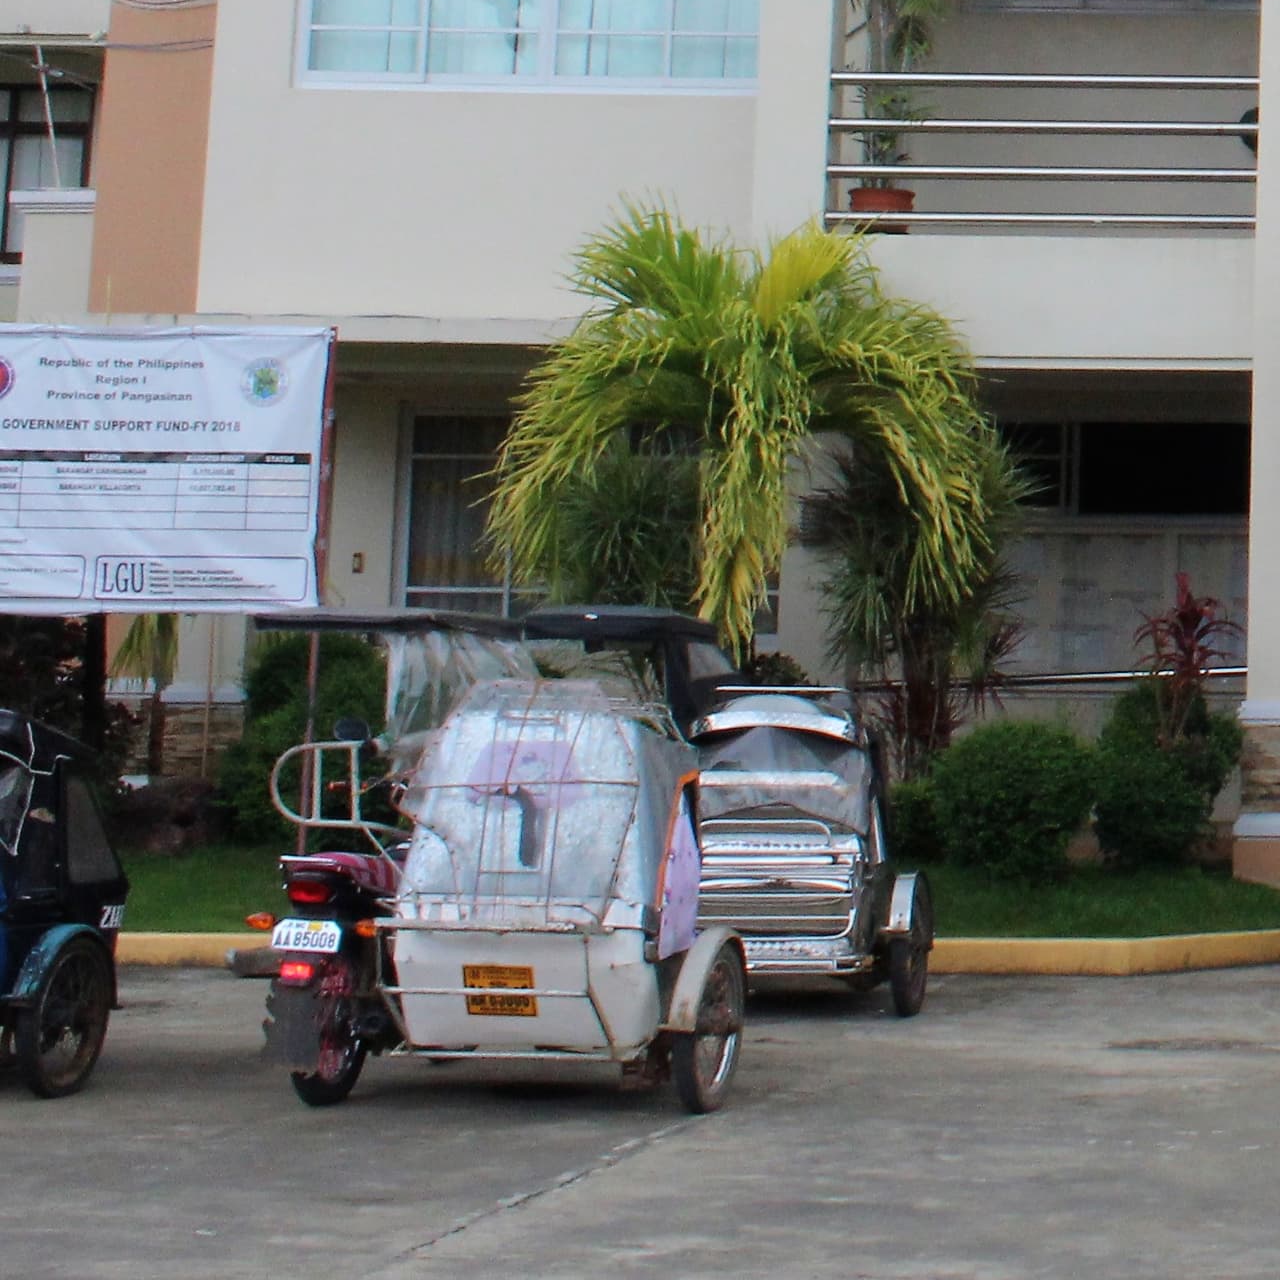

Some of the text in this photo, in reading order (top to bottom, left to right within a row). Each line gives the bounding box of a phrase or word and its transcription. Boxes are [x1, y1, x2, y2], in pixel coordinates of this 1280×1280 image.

[39, 356, 205, 371] Republic of the Philippines
[95, 374, 139, 386] Region
[47, 389, 193, 403] Province of Pangasinan
[1, 419, 241, 433] GOVERNMENT SUPPORT FUND-FY 2018
[102, 561, 146, 594] LGU
